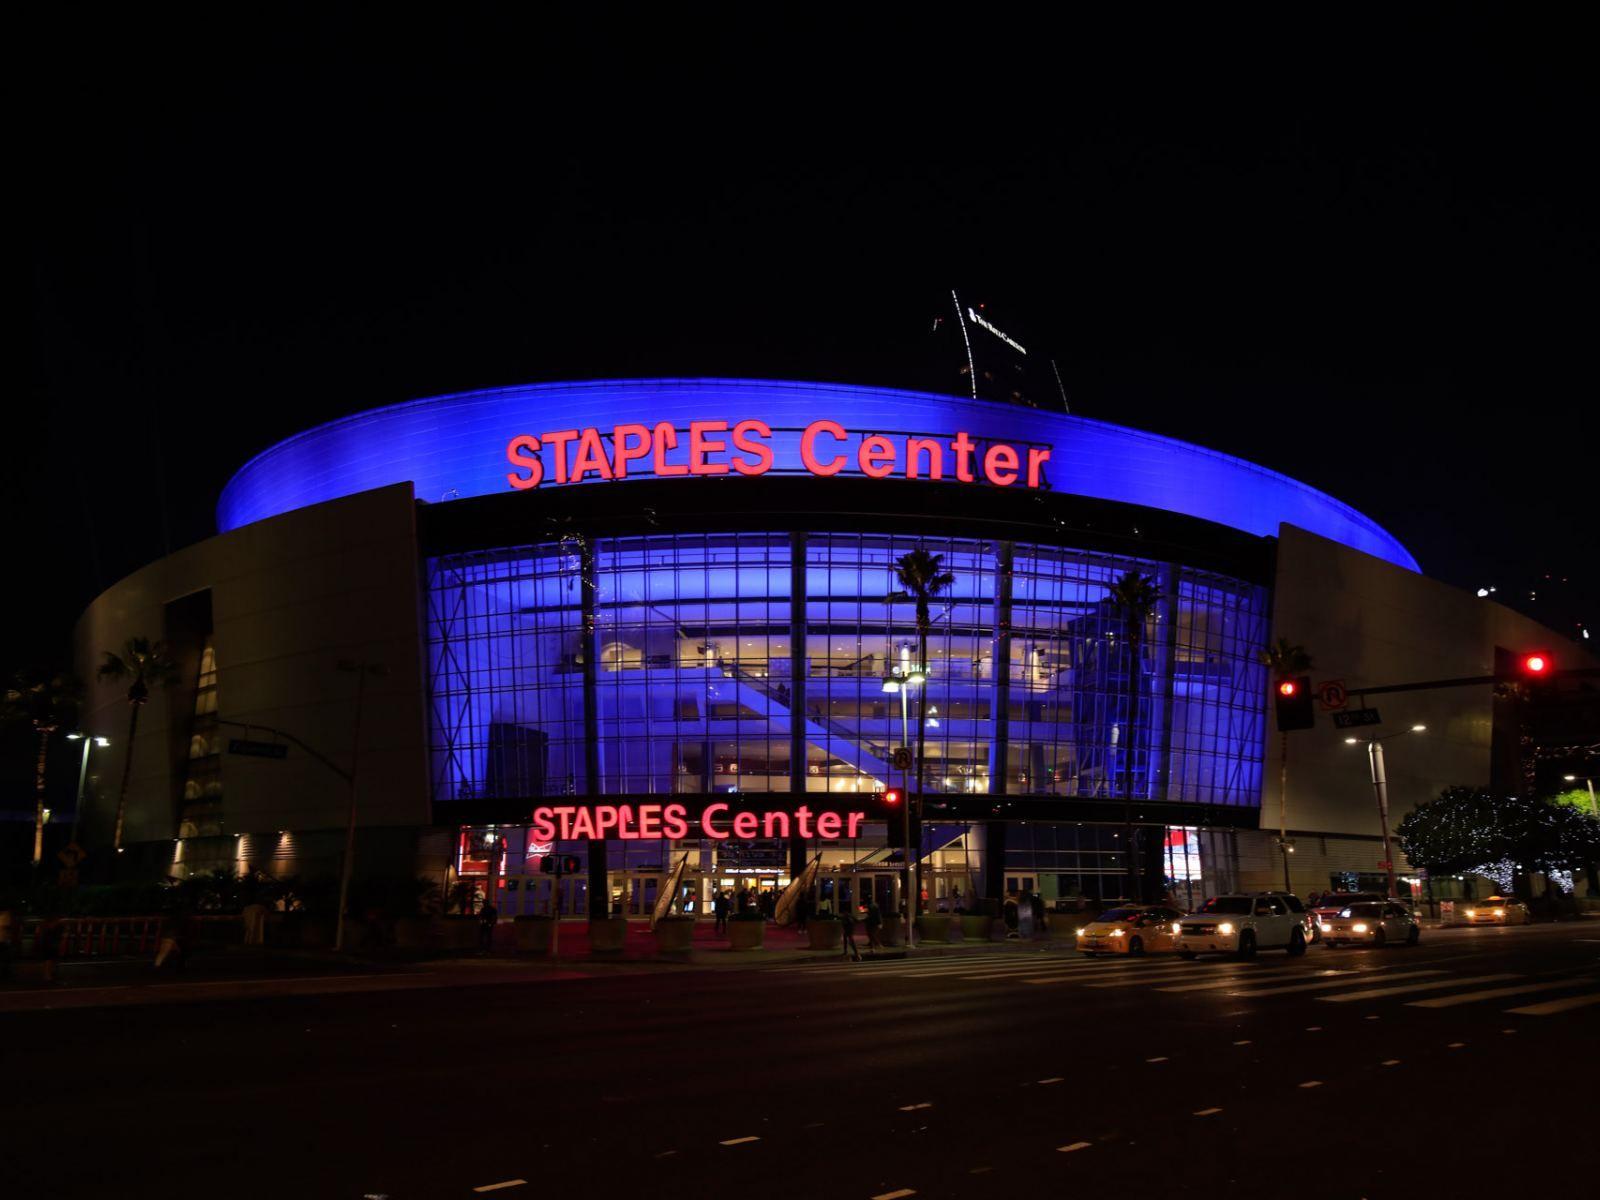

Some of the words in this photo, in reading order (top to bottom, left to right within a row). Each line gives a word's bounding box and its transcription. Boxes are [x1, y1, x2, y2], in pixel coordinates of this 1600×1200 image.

[507, 420, 774, 489] STAPLES
[800, 421, 1050, 487] Center
[533, 803, 688, 840] STAPLES
[702, 804, 864, 838] Center
